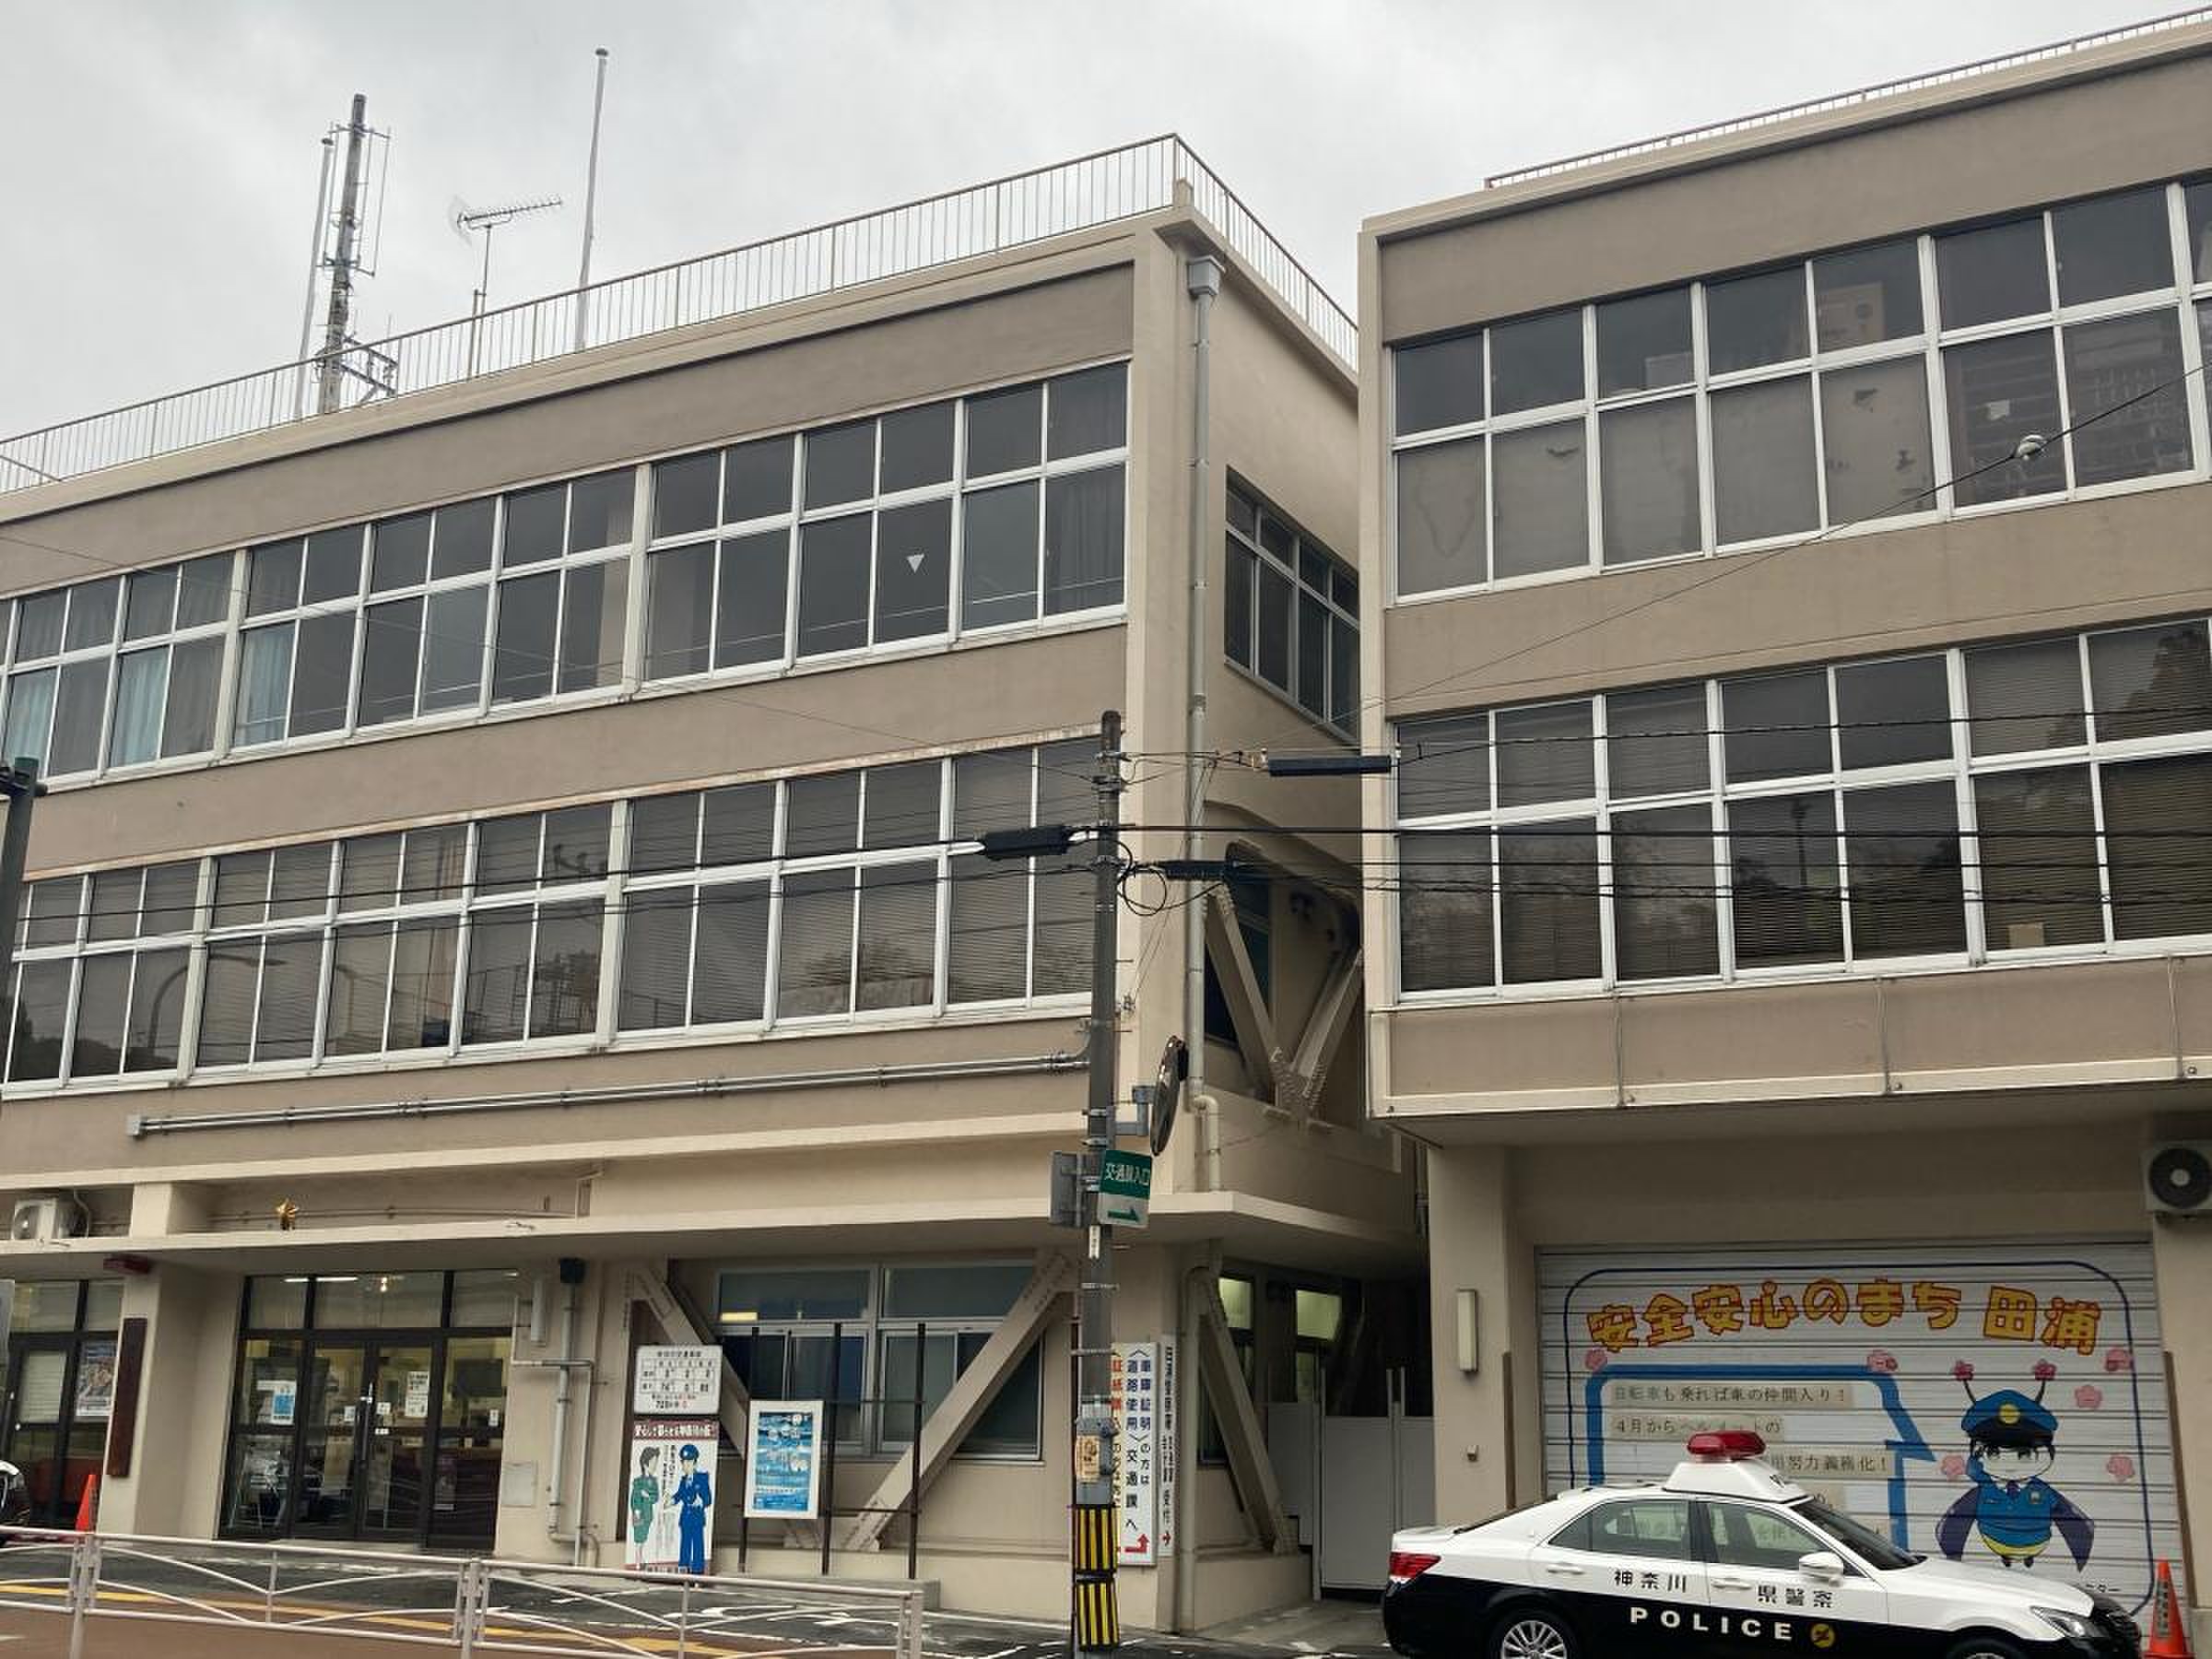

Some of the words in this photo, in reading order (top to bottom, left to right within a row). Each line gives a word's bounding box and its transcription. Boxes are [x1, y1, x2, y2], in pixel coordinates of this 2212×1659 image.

[1587, 1277, 1962, 1353] 安全安心のまち
[1983, 1286, 2102, 1356] 田浦
[1614, 1570, 1687, 1594] 神奈川
[1758, 1585, 1832, 1608] 県警察
[1630, 1606, 1793, 1641] POLICE
